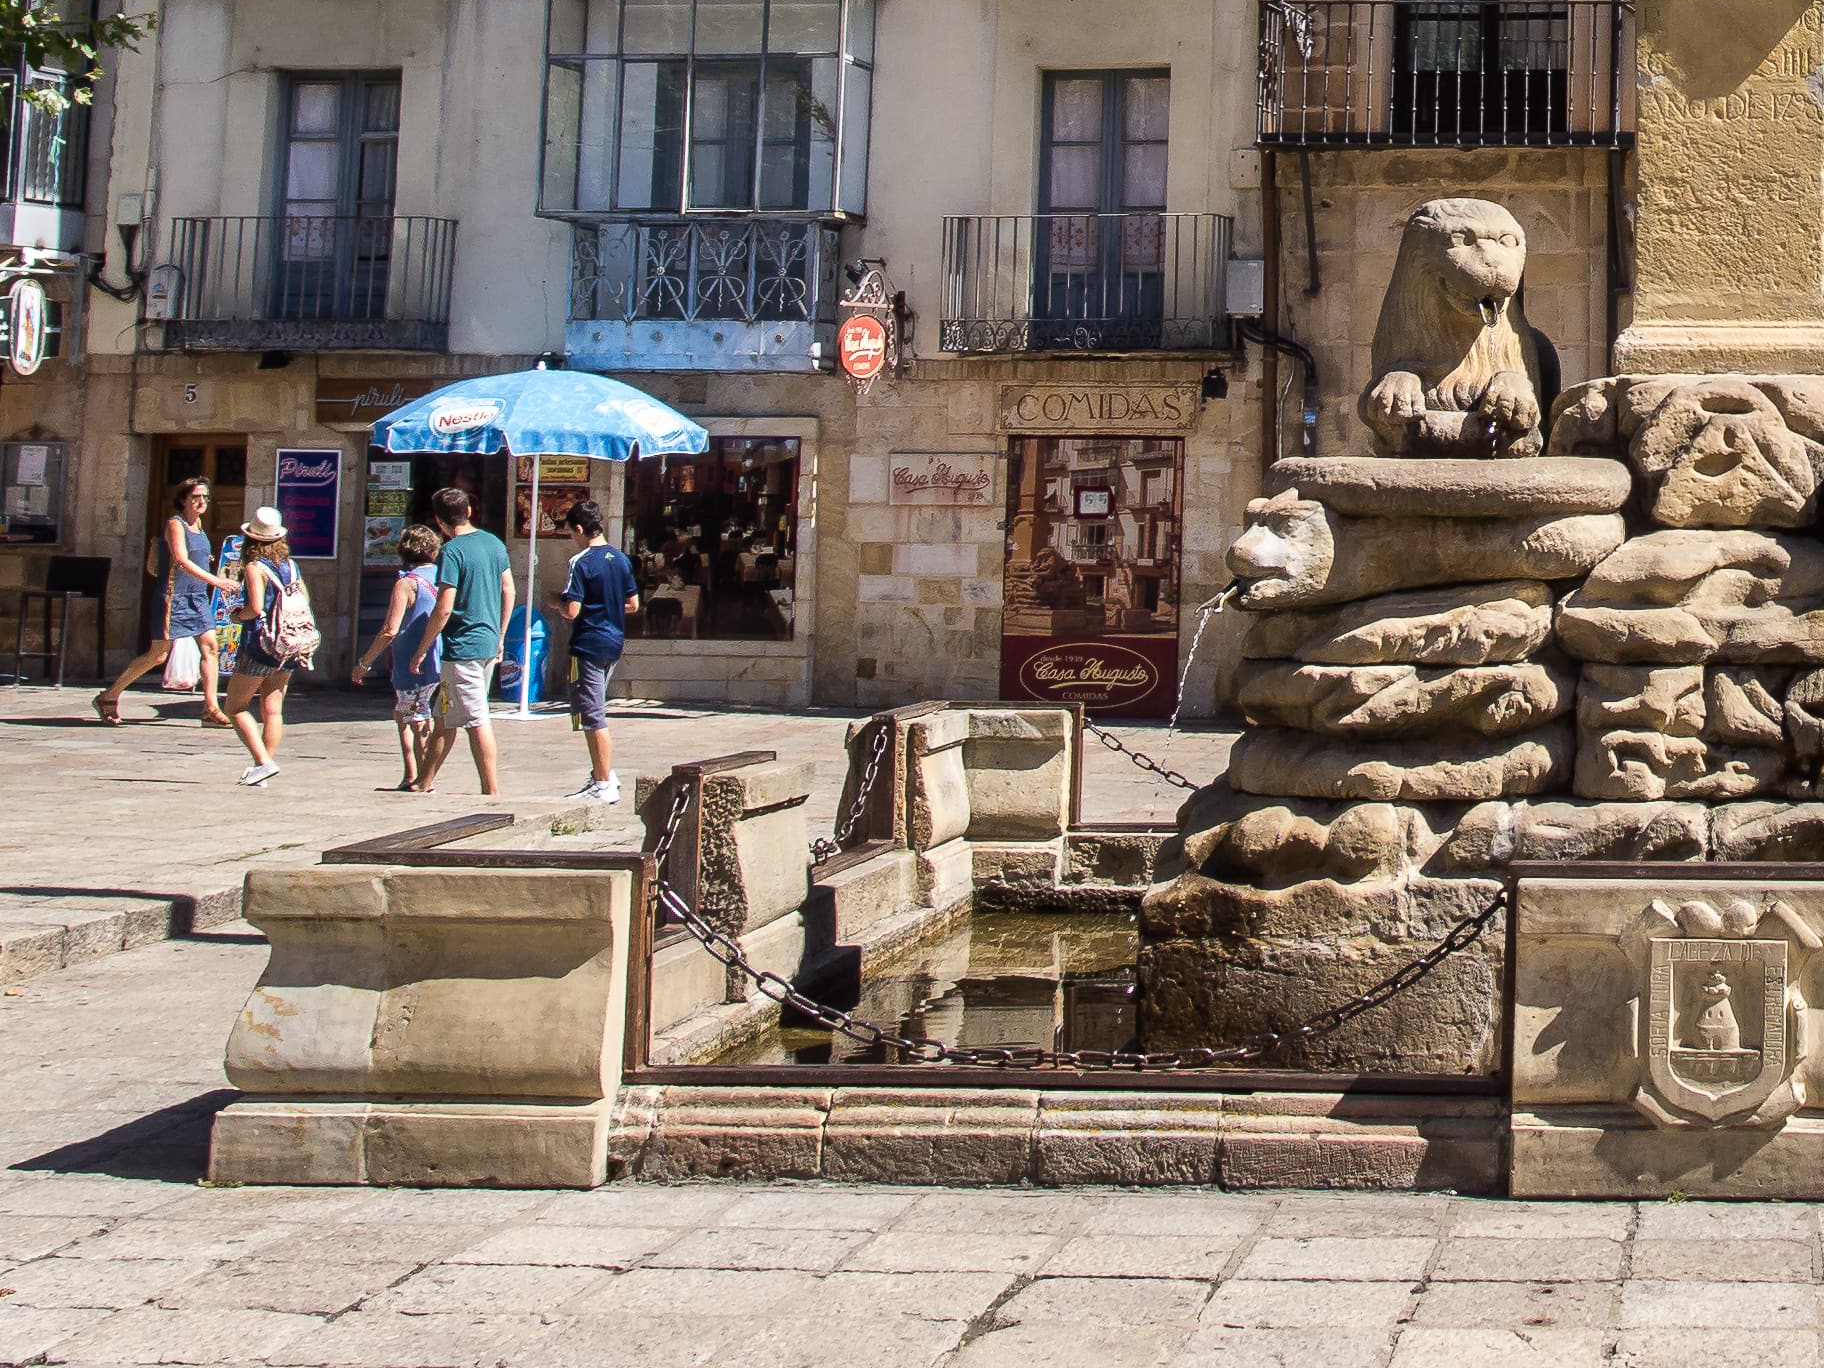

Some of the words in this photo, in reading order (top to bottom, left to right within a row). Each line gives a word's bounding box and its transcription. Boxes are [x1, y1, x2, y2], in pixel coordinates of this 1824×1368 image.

[183, 383, 199, 404] 5
[1016, 390, 1183, 421] COMIDAS
[893, 466, 929, 485] Casa
[1033, 661, 1076, 680] Casa
[1079, 657, 1149, 691] Augusto
[1062, 691, 1109, 700] COMIDAS
[1667, 941, 1732, 961] CABEZA
[1739, 941, 1762, 961] DE
[1649, 964, 1670, 1004] PURA
[1649, 1009, 1669, 1058] SORIA
